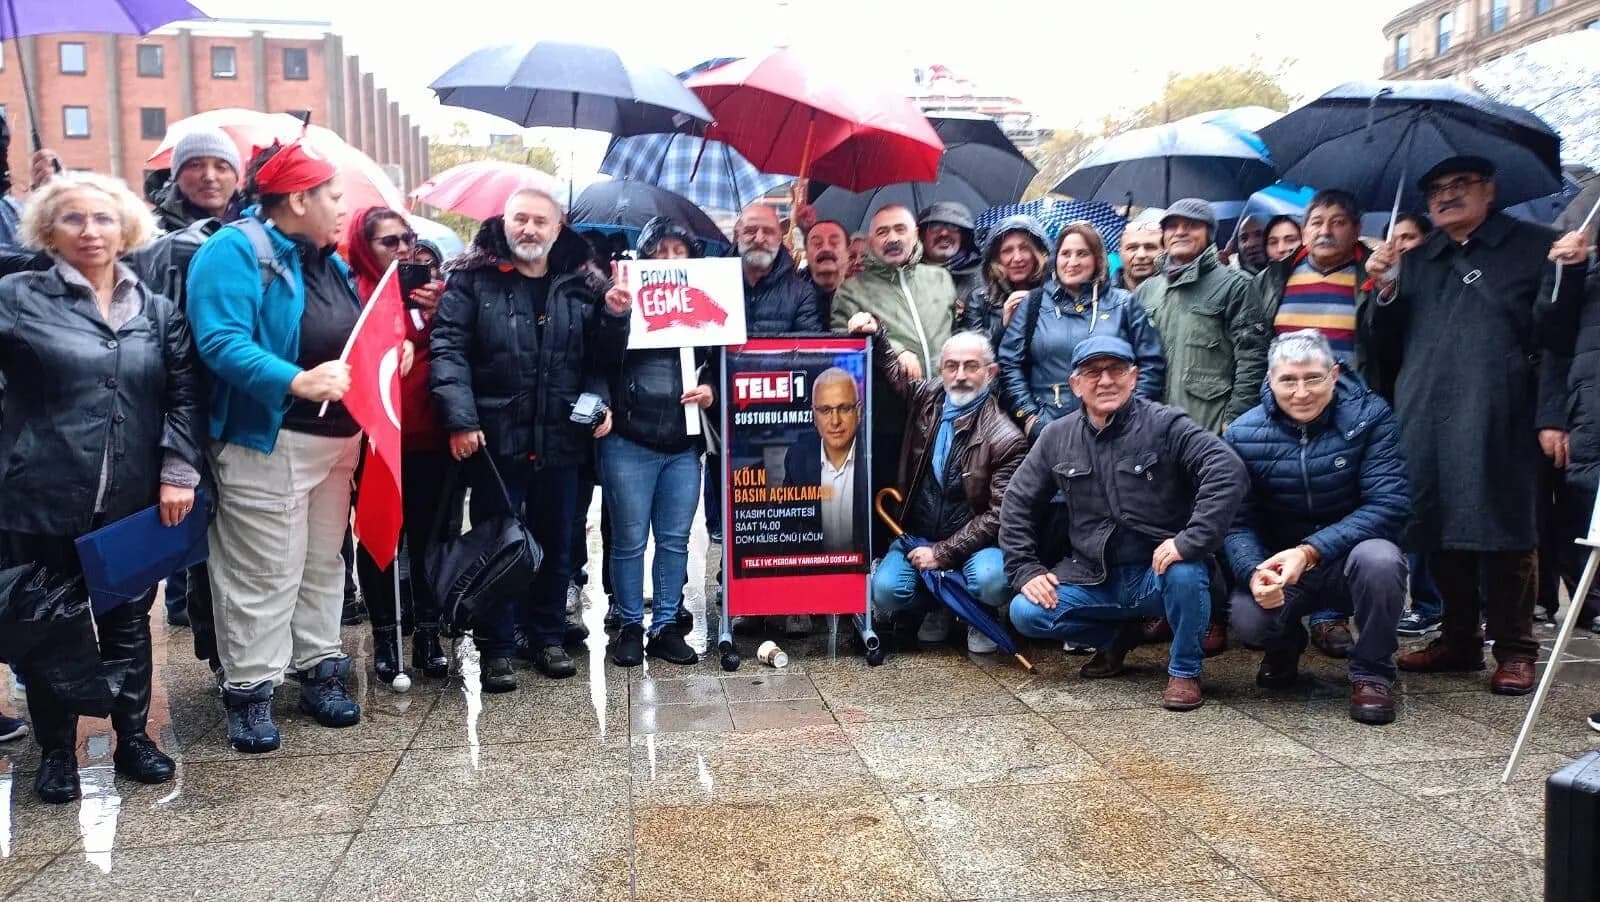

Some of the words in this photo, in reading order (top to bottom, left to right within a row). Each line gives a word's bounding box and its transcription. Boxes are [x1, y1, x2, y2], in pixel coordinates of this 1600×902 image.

[735, 376, 789, 399] TELE
[794, 376, 804, 398] 1
[735, 410, 813, 425] SUSTURULAMAZ!
[734, 467, 766, 487] KÖLN
[735, 487, 766, 503] BASIN
[740, 508, 766, 520] KASIM
[767, 505, 815, 519] CUMARTESİ
[735, 522, 757, 532] SAAT
[759, 520, 781, 531] 14.00
[735, 535, 755, 545] DOM
[779, 532, 798, 542] ÖNÜ
[802, 531, 824, 541] KÖLN
